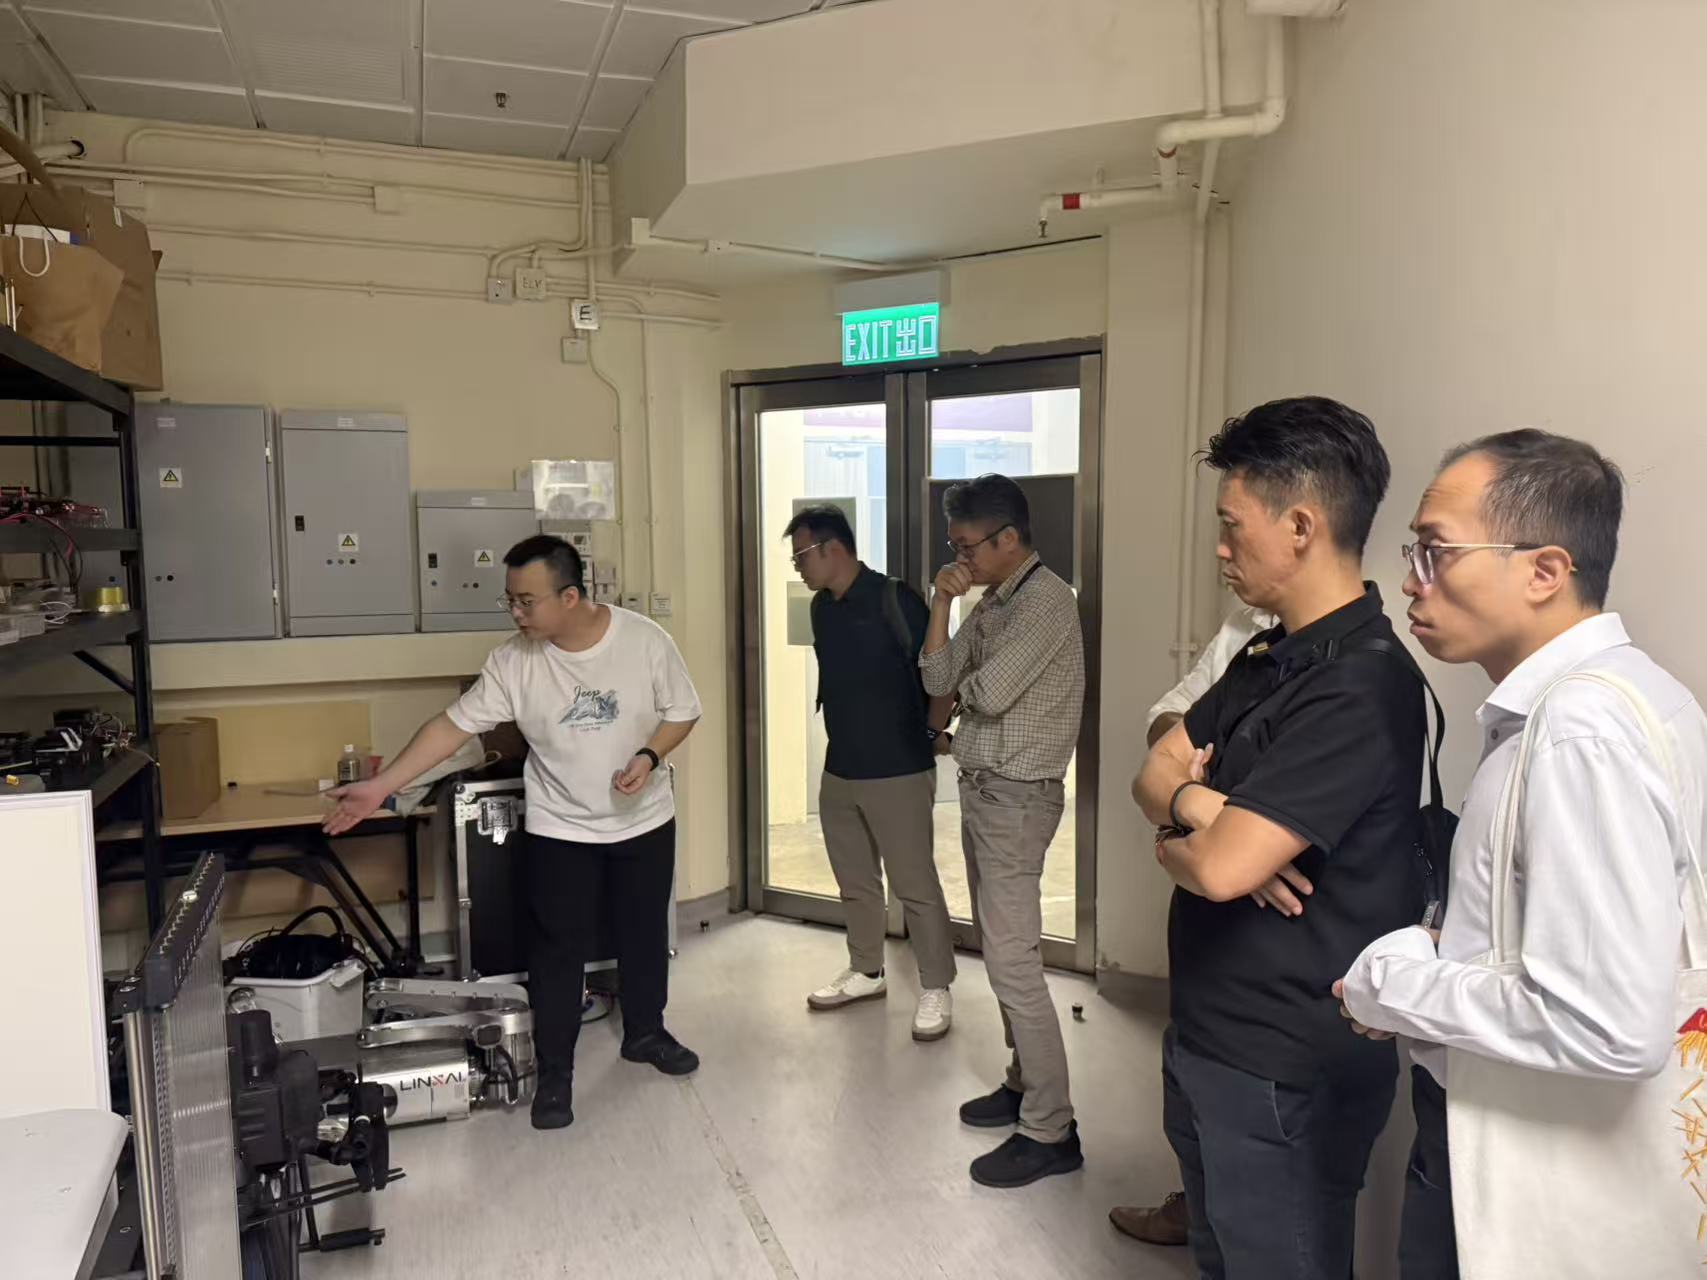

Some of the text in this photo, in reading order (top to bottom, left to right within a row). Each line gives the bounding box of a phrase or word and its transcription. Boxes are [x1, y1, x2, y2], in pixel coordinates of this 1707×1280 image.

[580, 304, 592, 321] E
[846, 315, 937, 361] EXIT 出口
[573, 685, 601, 704] Jeep
